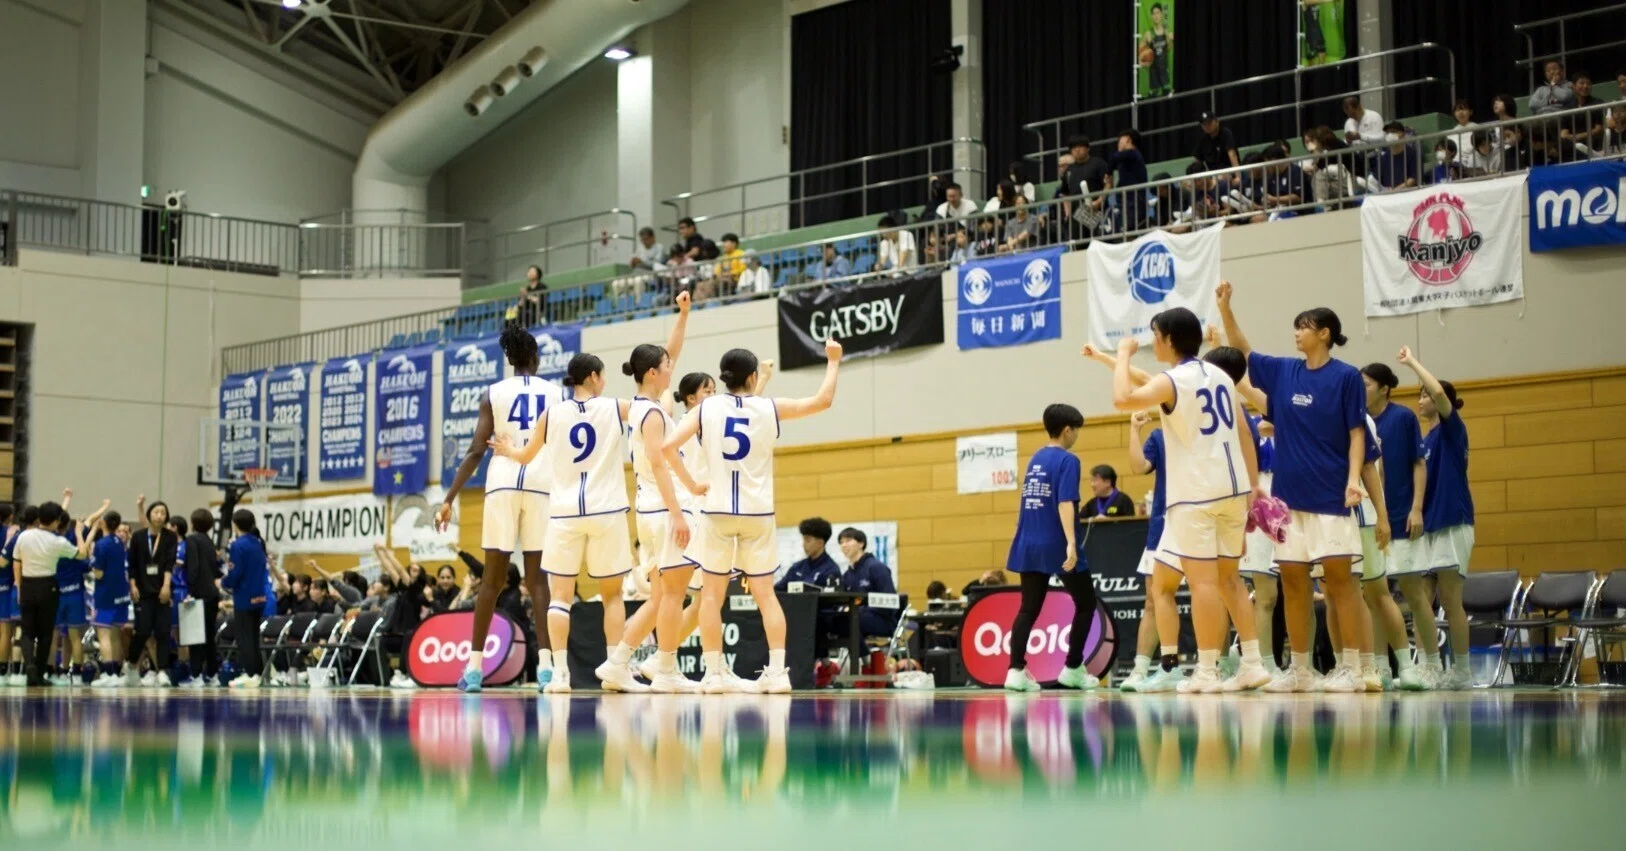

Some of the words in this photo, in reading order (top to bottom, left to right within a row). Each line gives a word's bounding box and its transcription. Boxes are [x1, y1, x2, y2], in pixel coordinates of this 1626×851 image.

[1398, 231, 1483, 266] Kanjyo
[809, 294, 906, 343] GATSBY
[273, 403, 302, 424] 2022
[386, 395, 419, 423] 2016
[507, 393, 546, 430] 41
[1195, 384, 1234, 435] 30
[322, 426, 362, 443] CHAMPIONS
[378, 423, 425, 445] CHAMPIONS
[569, 421, 597, 463] 9
[722, 416, 751, 461] 5
[263, 512, 285, 542] TO
[288, 505, 386, 540] CHAMPION
[418, 634, 501, 664] Qoo0
